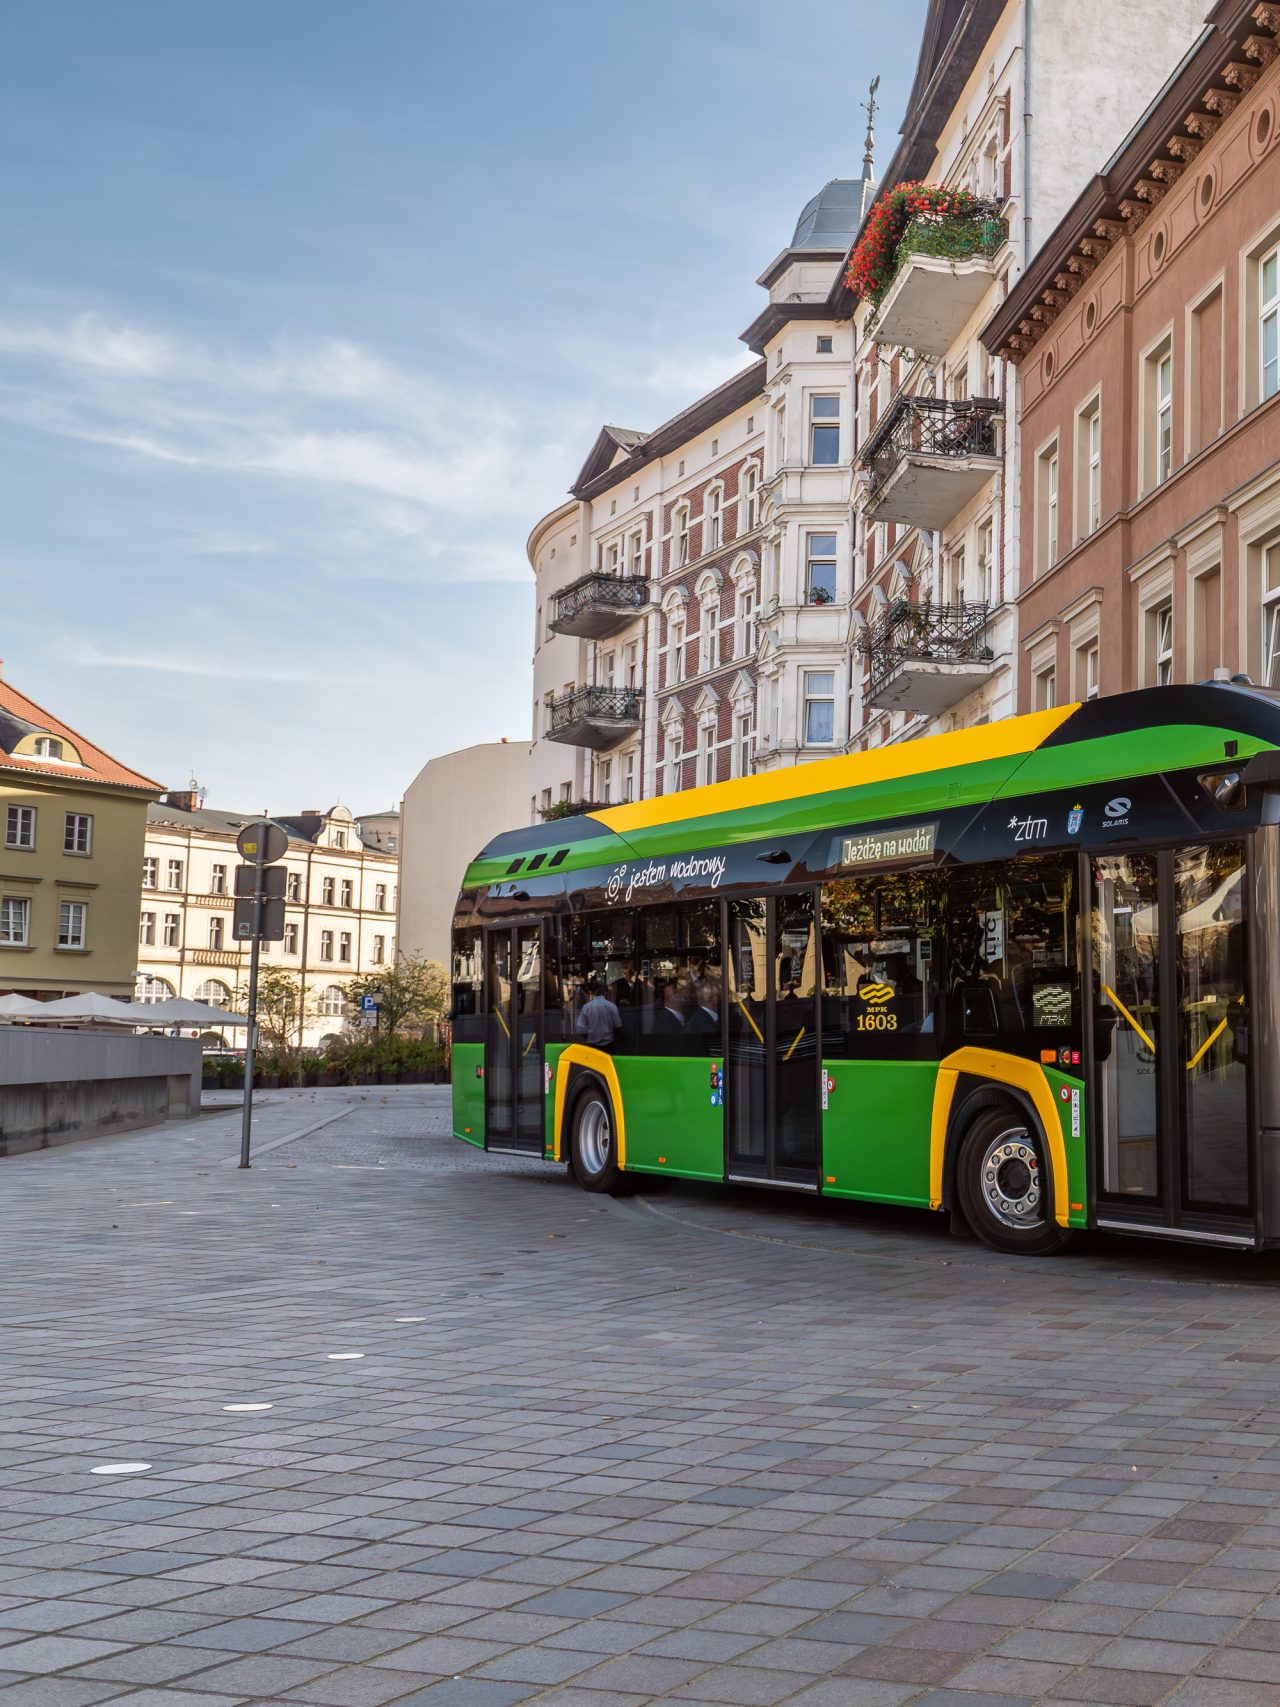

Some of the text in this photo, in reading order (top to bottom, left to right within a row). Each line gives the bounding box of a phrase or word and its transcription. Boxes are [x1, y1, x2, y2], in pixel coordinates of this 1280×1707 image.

[1101, 818, 1129, 828] SOLARIS
[843, 829, 931, 864] Jeżdżę na wodór
[625, 855, 726, 902] jestem wodorowy
[364, 997, 374, 1009] P
[857, 1014, 897, 1031] 1603
[1039, 1014, 1067, 1025] MPK
